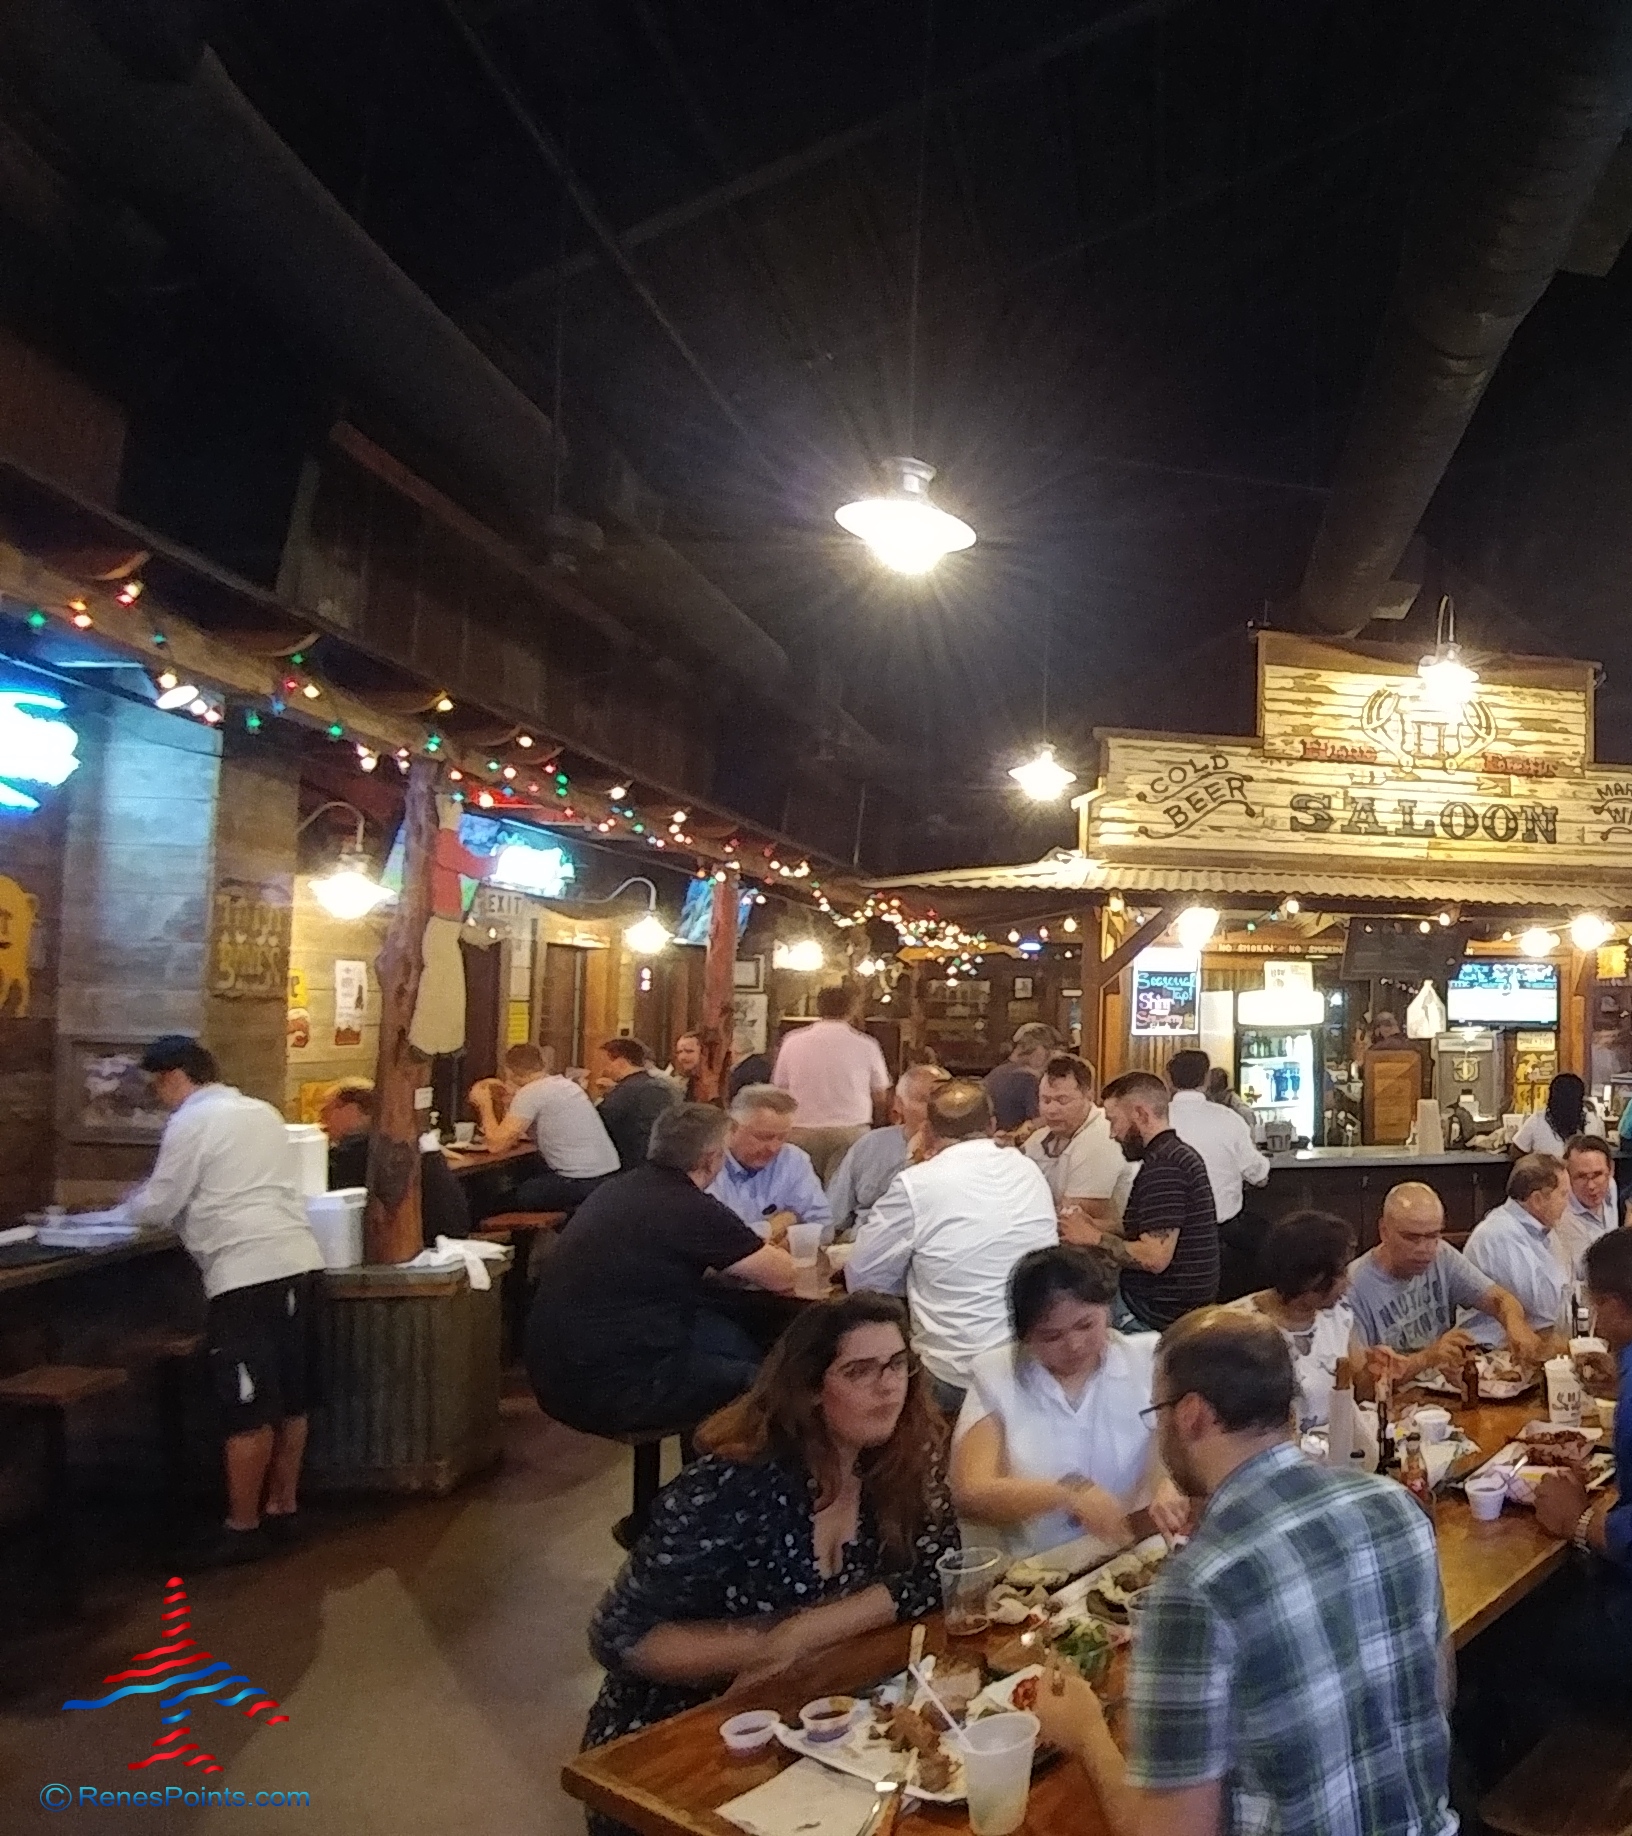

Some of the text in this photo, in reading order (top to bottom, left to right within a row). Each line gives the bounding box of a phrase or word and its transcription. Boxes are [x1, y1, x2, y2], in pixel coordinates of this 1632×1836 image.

[1150, 754, 1229, 794] COLD
[1163, 777, 1248, 829] BEER
[1290, 793, 1559, 844] SALOON
[489, 893, 521, 915] EXIT
[1218, 944, 1232, 953] NO
[1288, 945, 1302, 954] NO
